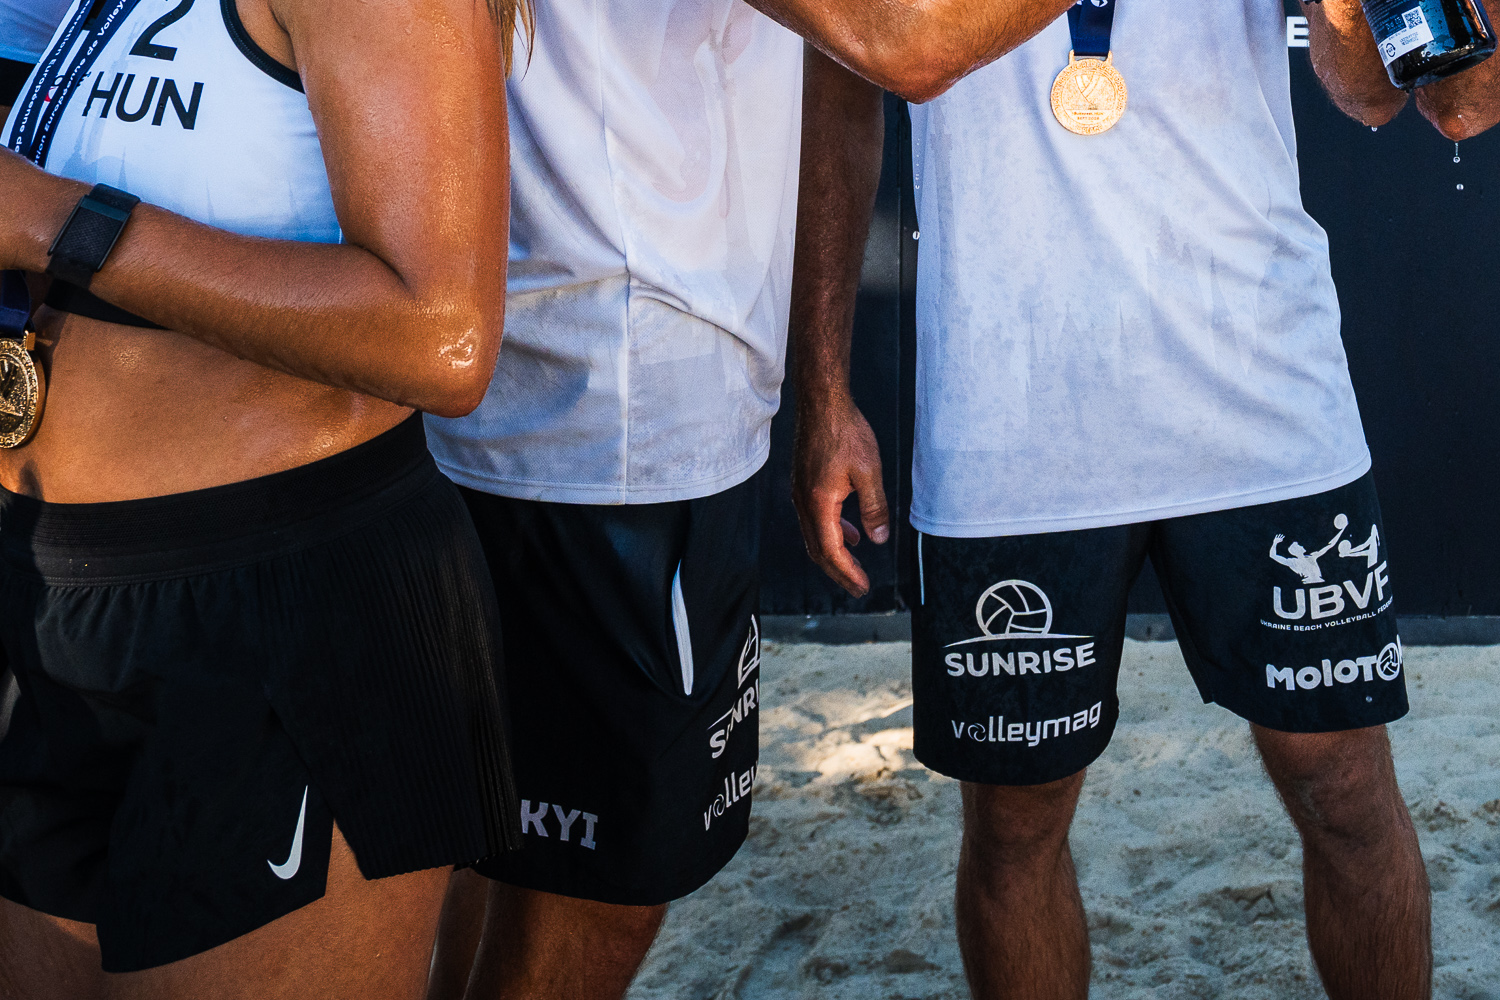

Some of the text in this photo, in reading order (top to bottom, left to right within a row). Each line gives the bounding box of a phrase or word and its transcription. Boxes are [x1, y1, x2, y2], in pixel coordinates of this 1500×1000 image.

[87, 39, 99, 57] de
[82, 70, 205, 131] HUN
[1273, 560, 1389, 621] UBVF
[1260, 619, 1292, 631] UKRAINE
[1293, 623, 1323, 632] BEACH
[1324, 611, 1377, 628] VOLLEYBALL
[944, 642, 1097, 678] SUNRISE
[951, 700, 1103, 748] volleymag
[520, 799, 599, 851] KYI
